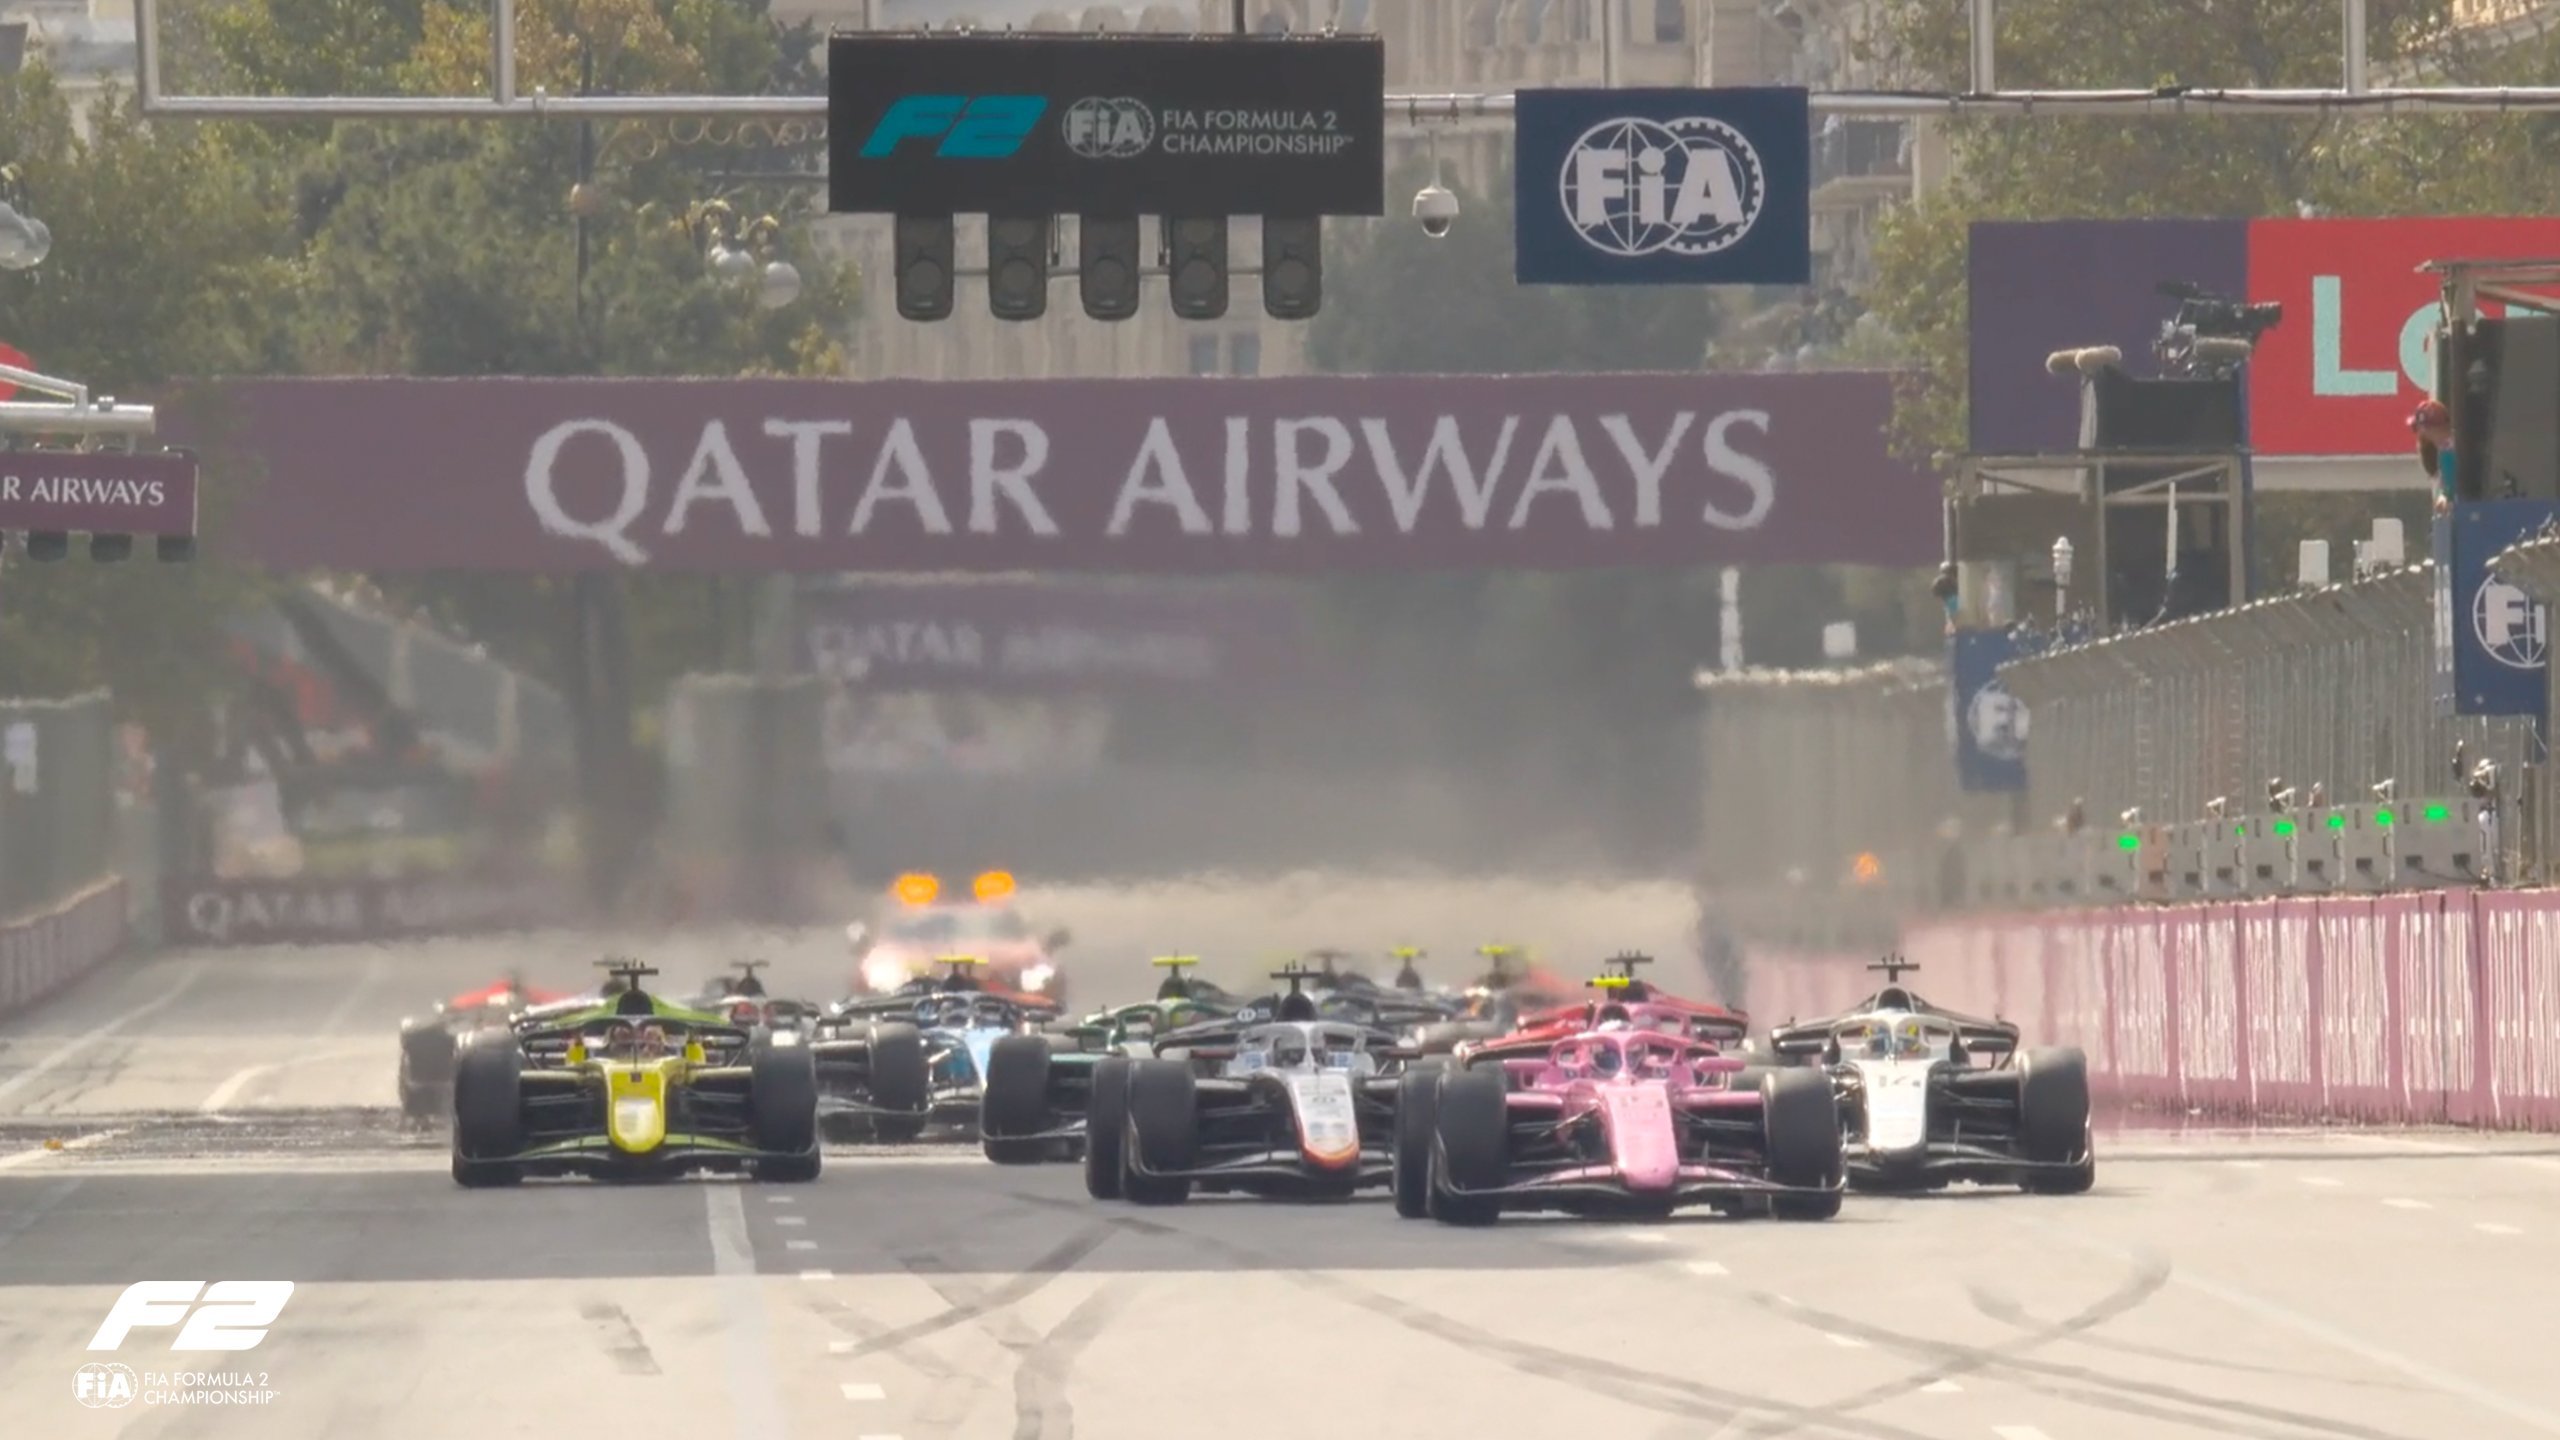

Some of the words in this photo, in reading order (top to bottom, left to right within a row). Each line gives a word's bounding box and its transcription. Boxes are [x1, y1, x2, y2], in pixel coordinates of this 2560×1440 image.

[859, 94, 1048, 158] F2
[1162, 110, 1199, 130] FIA
[1204, 110, 1318, 130] FORMULA
[1322, 110, 1338, 130] 2
[30, 476, 166, 507] AIRWAYS
[523, 417, 1061, 566] QATAR
[1105, 409, 1777, 538] AIRWAYS
